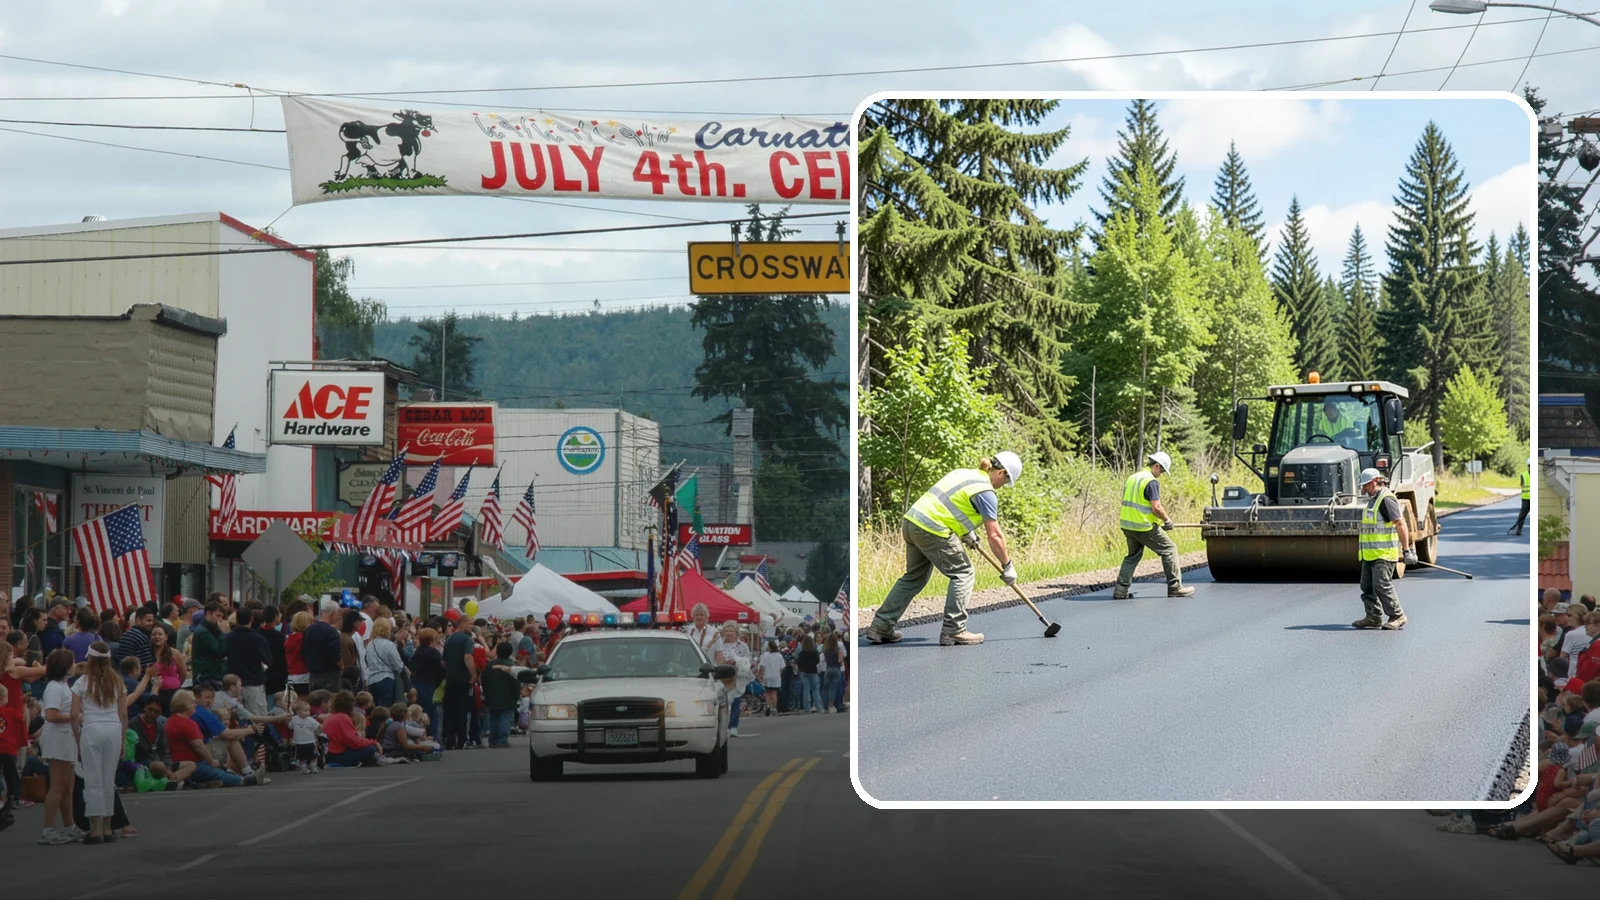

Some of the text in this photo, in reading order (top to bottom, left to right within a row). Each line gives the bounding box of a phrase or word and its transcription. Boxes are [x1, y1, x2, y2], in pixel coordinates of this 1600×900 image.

[481, 141, 604, 192] JULY
[632, 150, 746, 197] 4th.
[697, 254, 850, 280] CROSSWA
[283, 380, 373, 420] ACE
[406, 409, 452, 422] CEDAR
[284, 421, 371, 436] Hardware
[353, 466, 385, 483] Simpl
[83, 484, 155, 495] St. Vincent de Paul
[212, 516, 331, 535] HARDARE
[688, 526, 741, 535] CRNATION
[699, 535, 730, 543] GLASS
